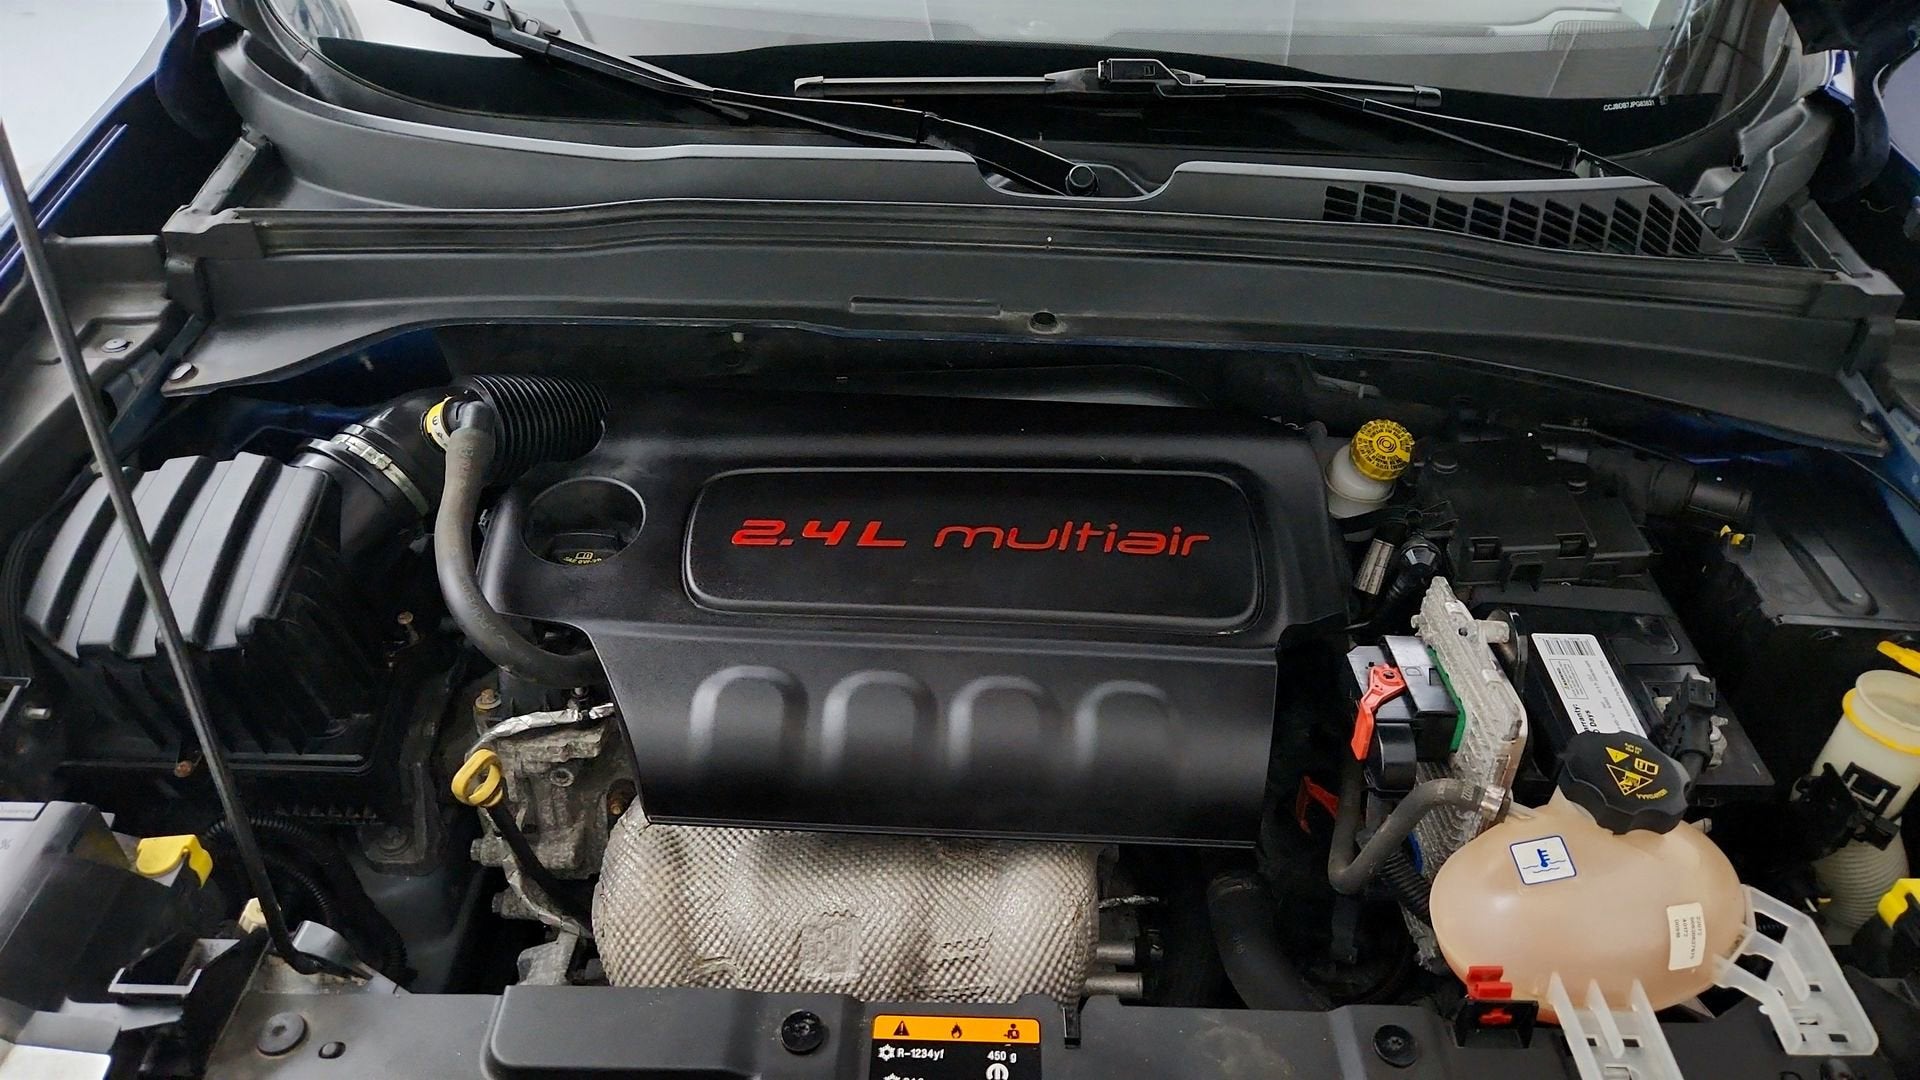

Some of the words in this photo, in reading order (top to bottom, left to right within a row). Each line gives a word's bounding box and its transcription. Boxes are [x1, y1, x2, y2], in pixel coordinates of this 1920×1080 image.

[934, 521, 1210, 556] multiair
[1585, 709, 1598, 727] Days
[896, 1047, 944, 1061] R-1234yf
[987, 1050, 1007, 1061] 450
[1009, 1052, 1017, 1063] g
